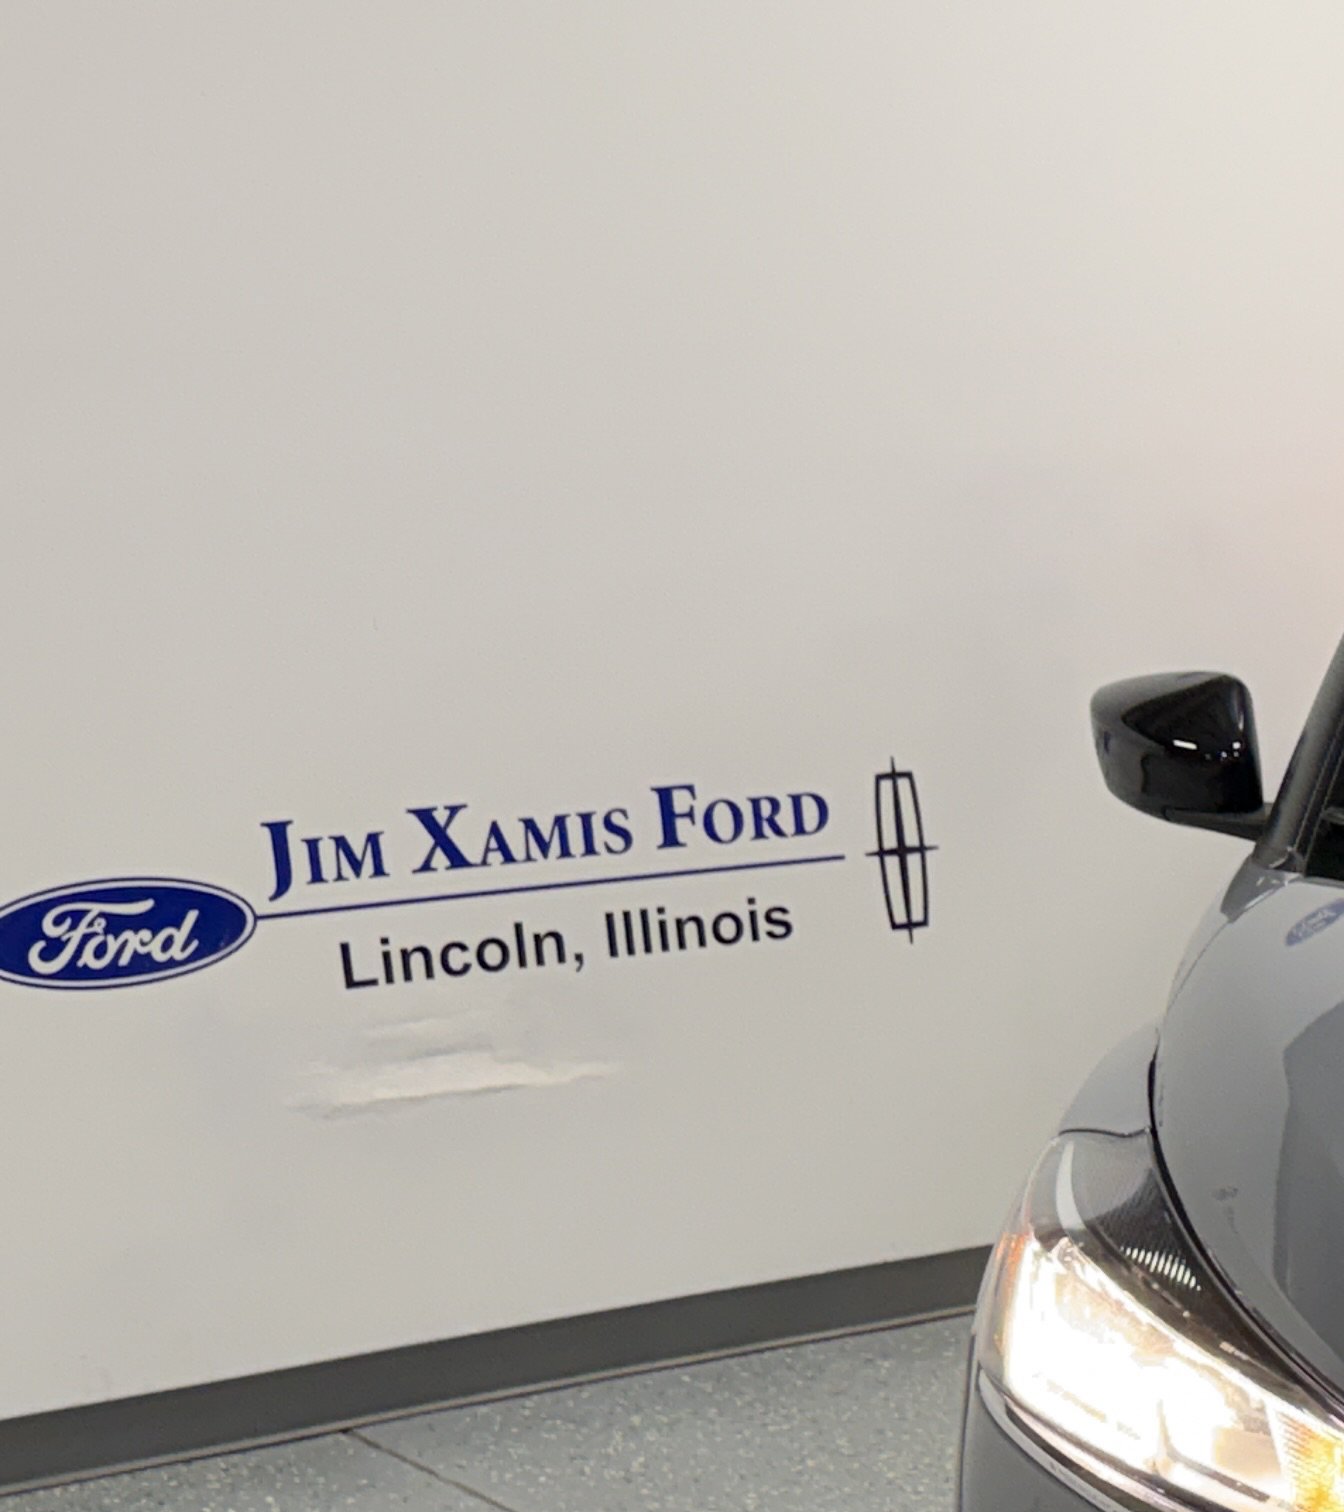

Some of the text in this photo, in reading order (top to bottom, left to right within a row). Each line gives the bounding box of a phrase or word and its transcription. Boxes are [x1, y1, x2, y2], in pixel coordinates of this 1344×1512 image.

[261, 783, 831, 902] JIM XAMIS FORD
[28, 899, 198, 975] Ford
[341, 897, 795, 989] Lincoln, Illinois
